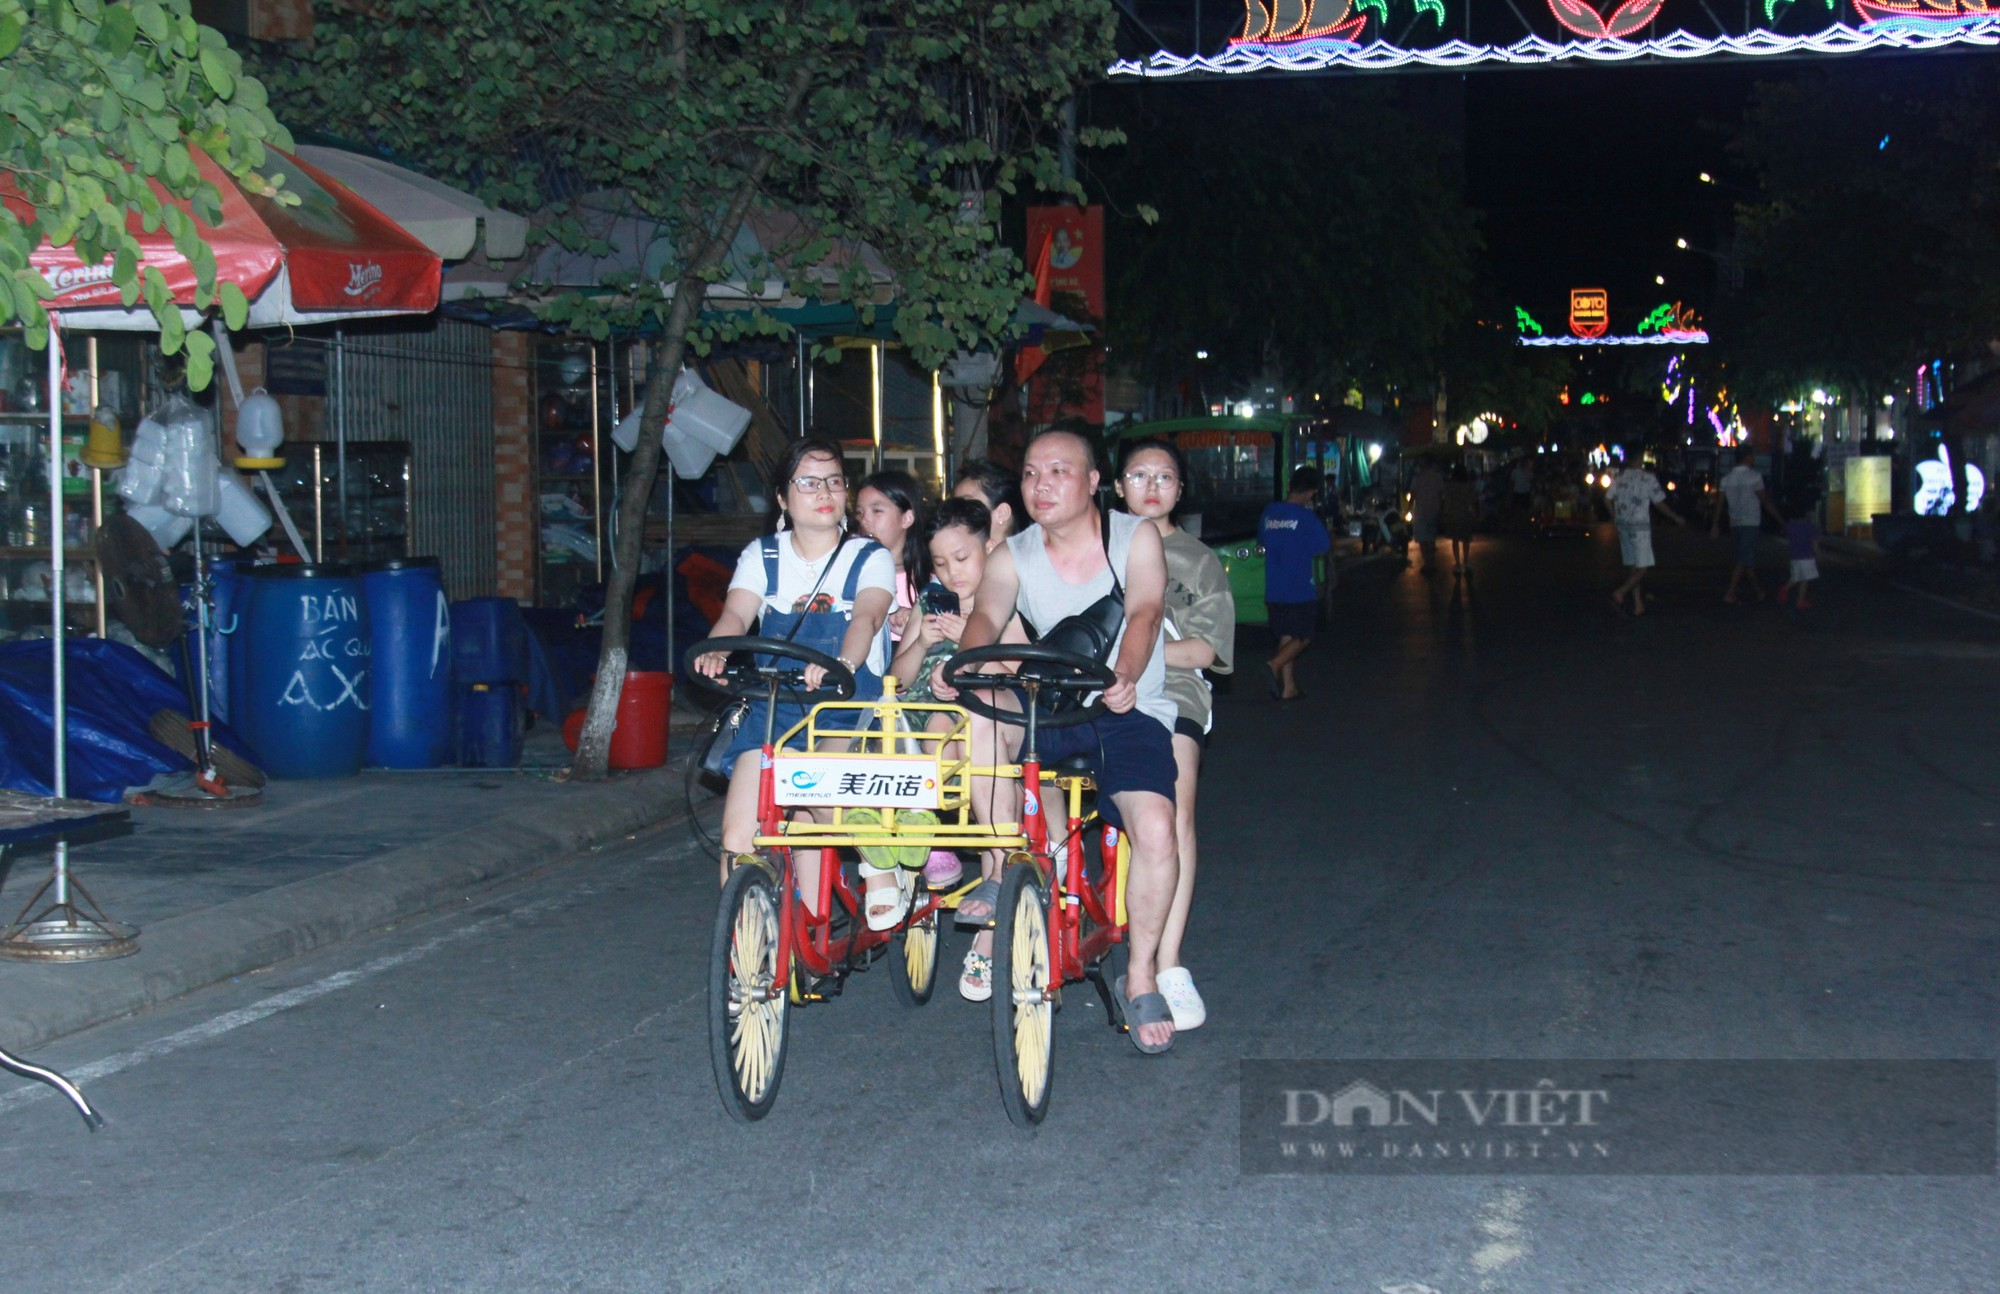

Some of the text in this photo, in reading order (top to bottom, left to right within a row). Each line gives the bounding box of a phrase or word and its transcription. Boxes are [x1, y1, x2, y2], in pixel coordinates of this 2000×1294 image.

[301, 587, 358, 623] BÁN
[838, 772, 922, 798] 美尔诺
